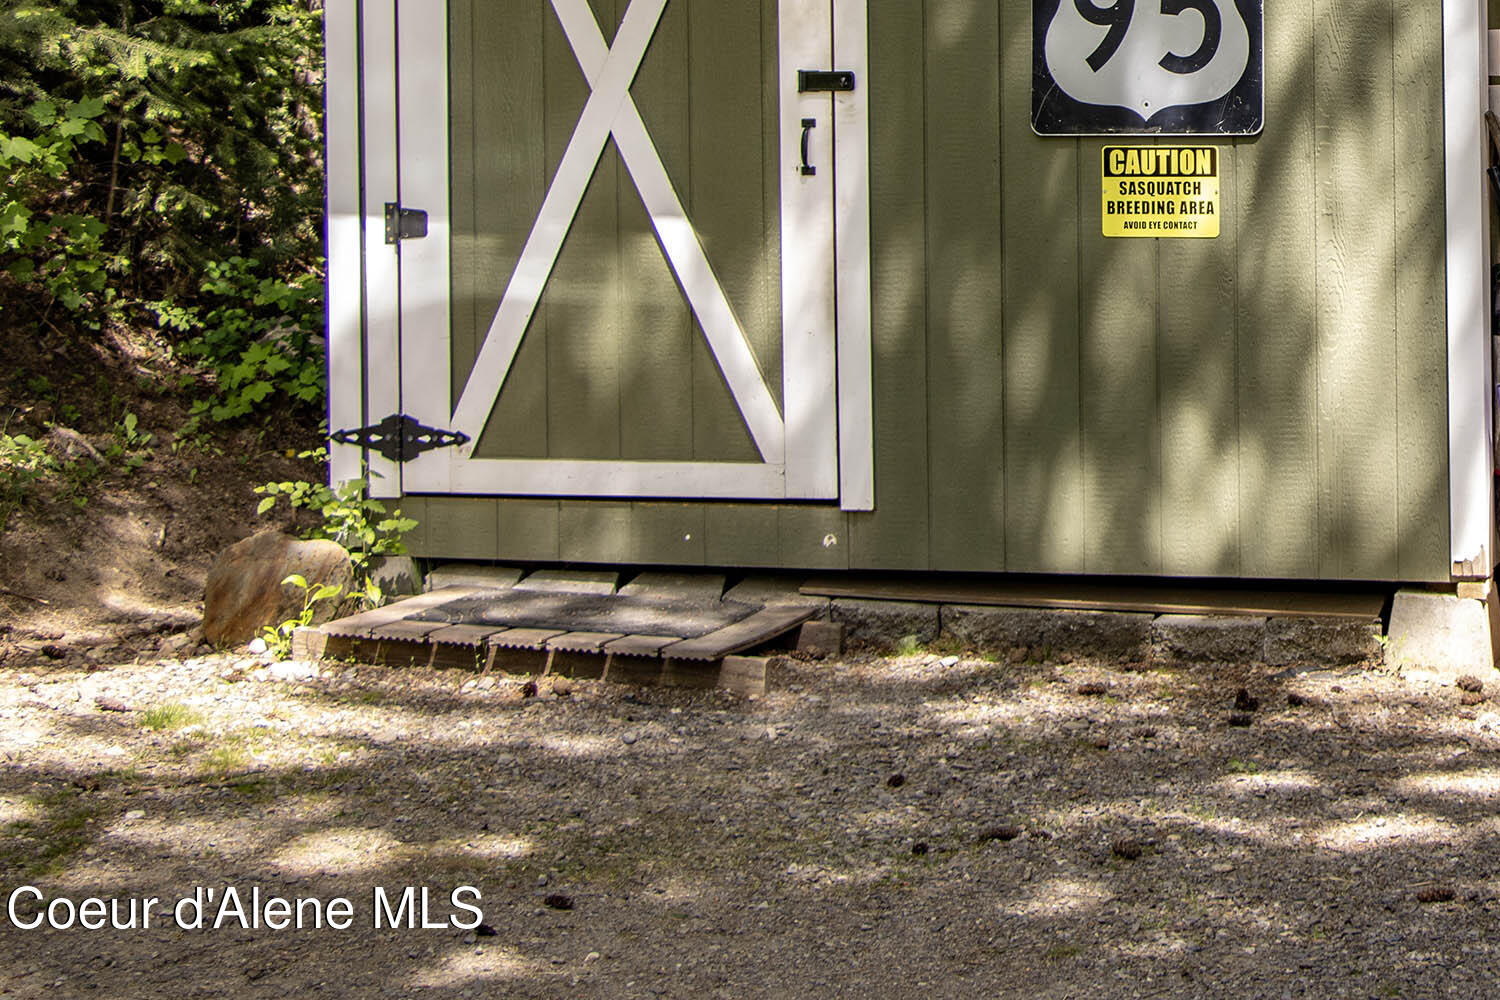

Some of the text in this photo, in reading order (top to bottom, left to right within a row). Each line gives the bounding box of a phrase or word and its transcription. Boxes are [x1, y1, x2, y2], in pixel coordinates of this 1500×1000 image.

[1109, 149, 1212, 175] CAUTION
[1119, 181, 1201, 197] SASQUATCH
[1107, 200, 1215, 215] BREEDING AREA
[1123, 221, 1198, 230] AVOID EYE CONTACT
